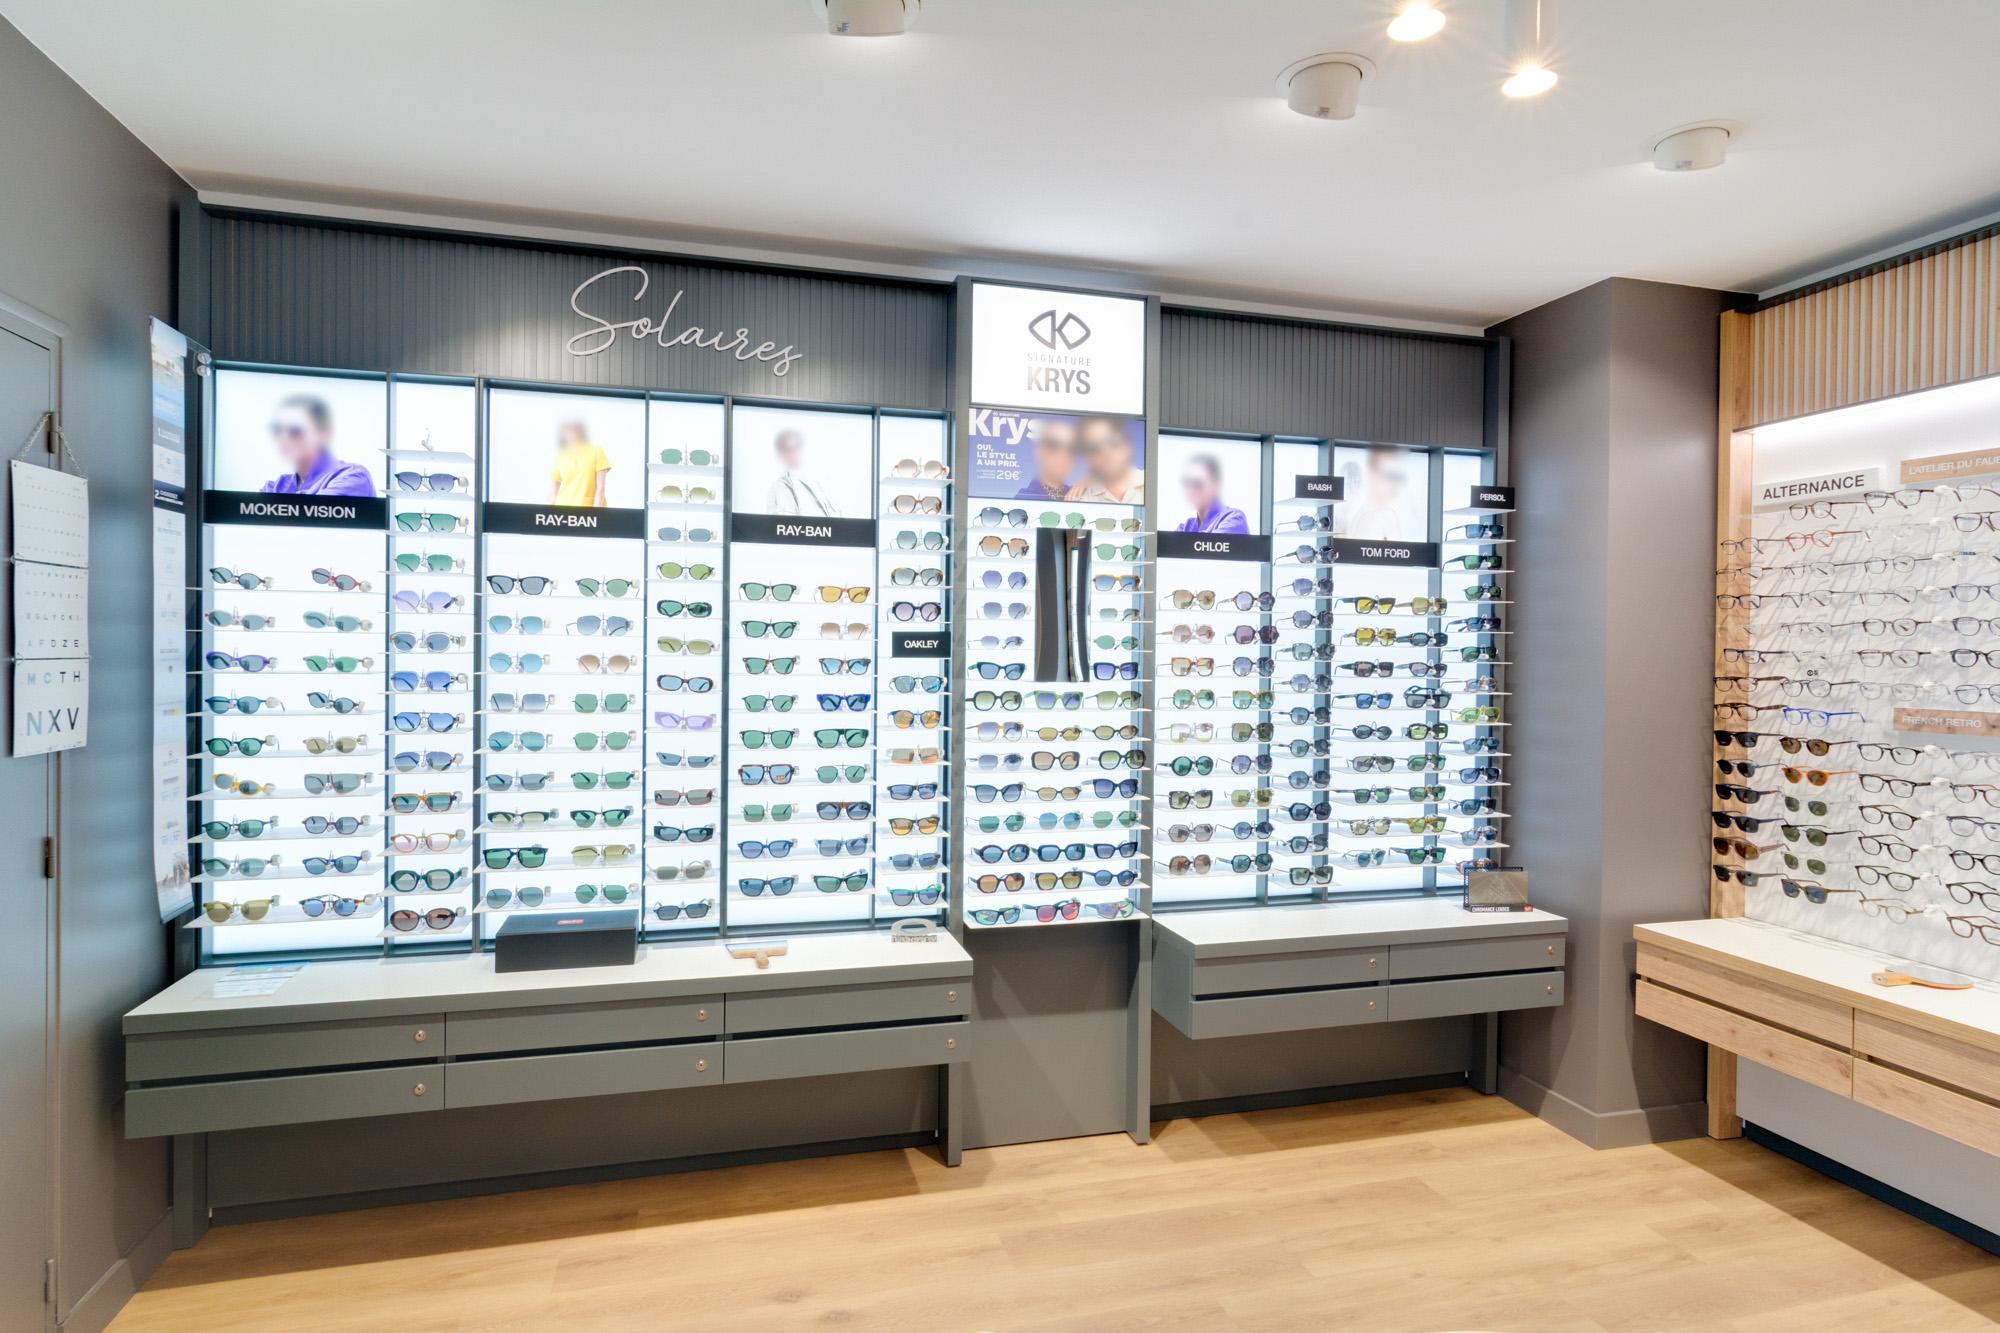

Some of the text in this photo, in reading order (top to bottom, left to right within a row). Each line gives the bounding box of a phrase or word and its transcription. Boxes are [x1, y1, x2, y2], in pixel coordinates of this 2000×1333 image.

[566, 266, 802, 377] Solaires
[1026, 352, 1092, 366] SIGNATURE
[1027, 366, 1091, 395] KRYS
[1957, 459, 1973, 471] DU
[1307, 483, 1332, 492] BA&SH
[1762, 474, 1865, 500] ALTERNANCE
[1479, 493, 1507, 502] PERSOL
[240, 502, 356, 519] MOKEN VISION
[535, 513, 597, 528] RAY-BAN
[776, 524, 832, 537] RAY-BAN
[1194, 541, 1230, 552] CHLOE
[1360, 547, 1410, 558] TOM FORD
[904, 640, 939, 648] OAKLEY
[1902, 716, 1982, 728] FRENCH RETRO
